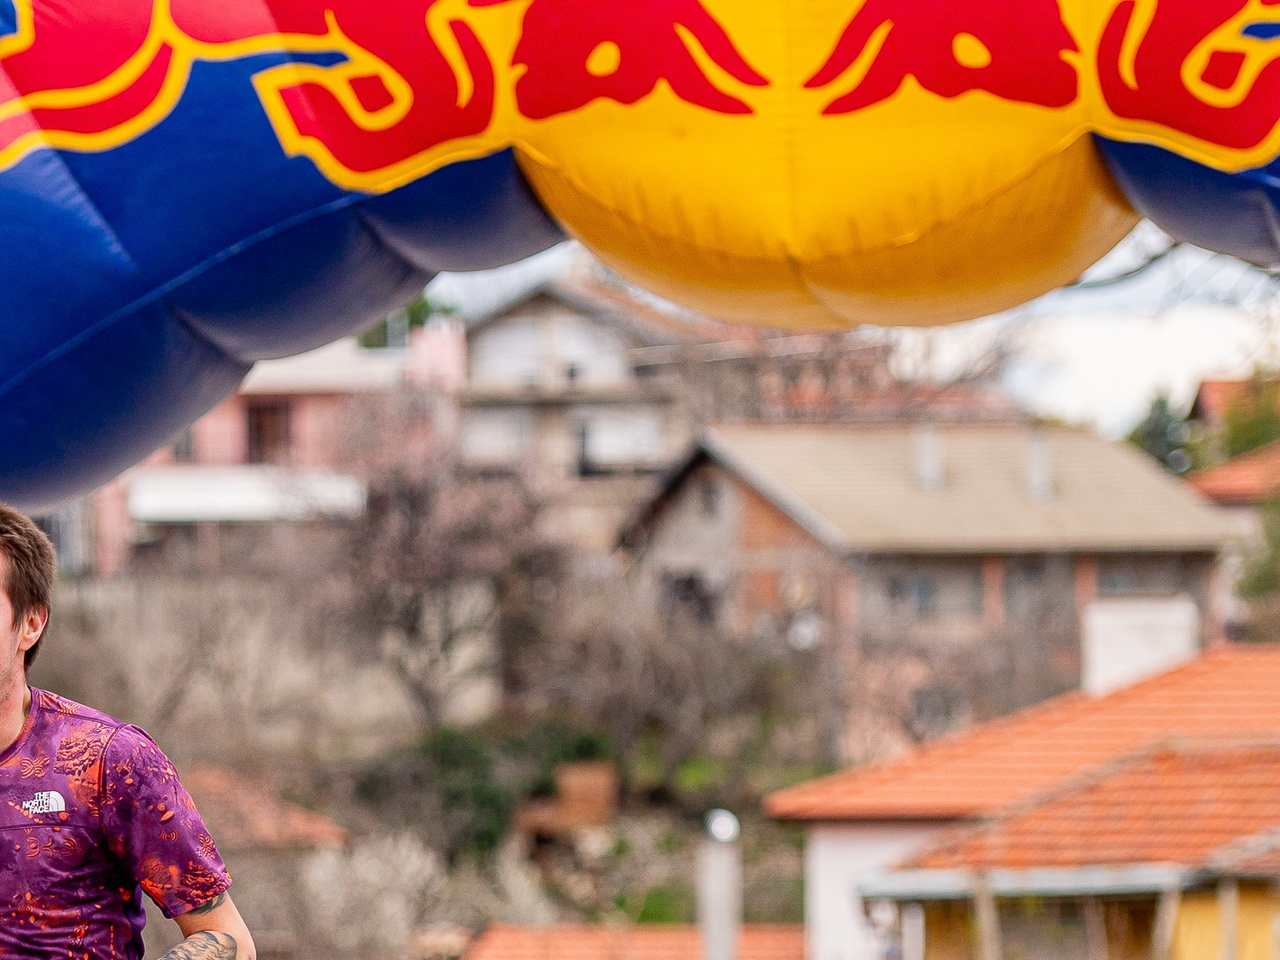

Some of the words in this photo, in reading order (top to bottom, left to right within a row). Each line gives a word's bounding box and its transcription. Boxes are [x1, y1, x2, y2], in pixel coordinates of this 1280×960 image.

[34, 791, 50, 800] THE
[22, 799, 49, 809] NORTH
[29, 806, 50, 815] FACE
